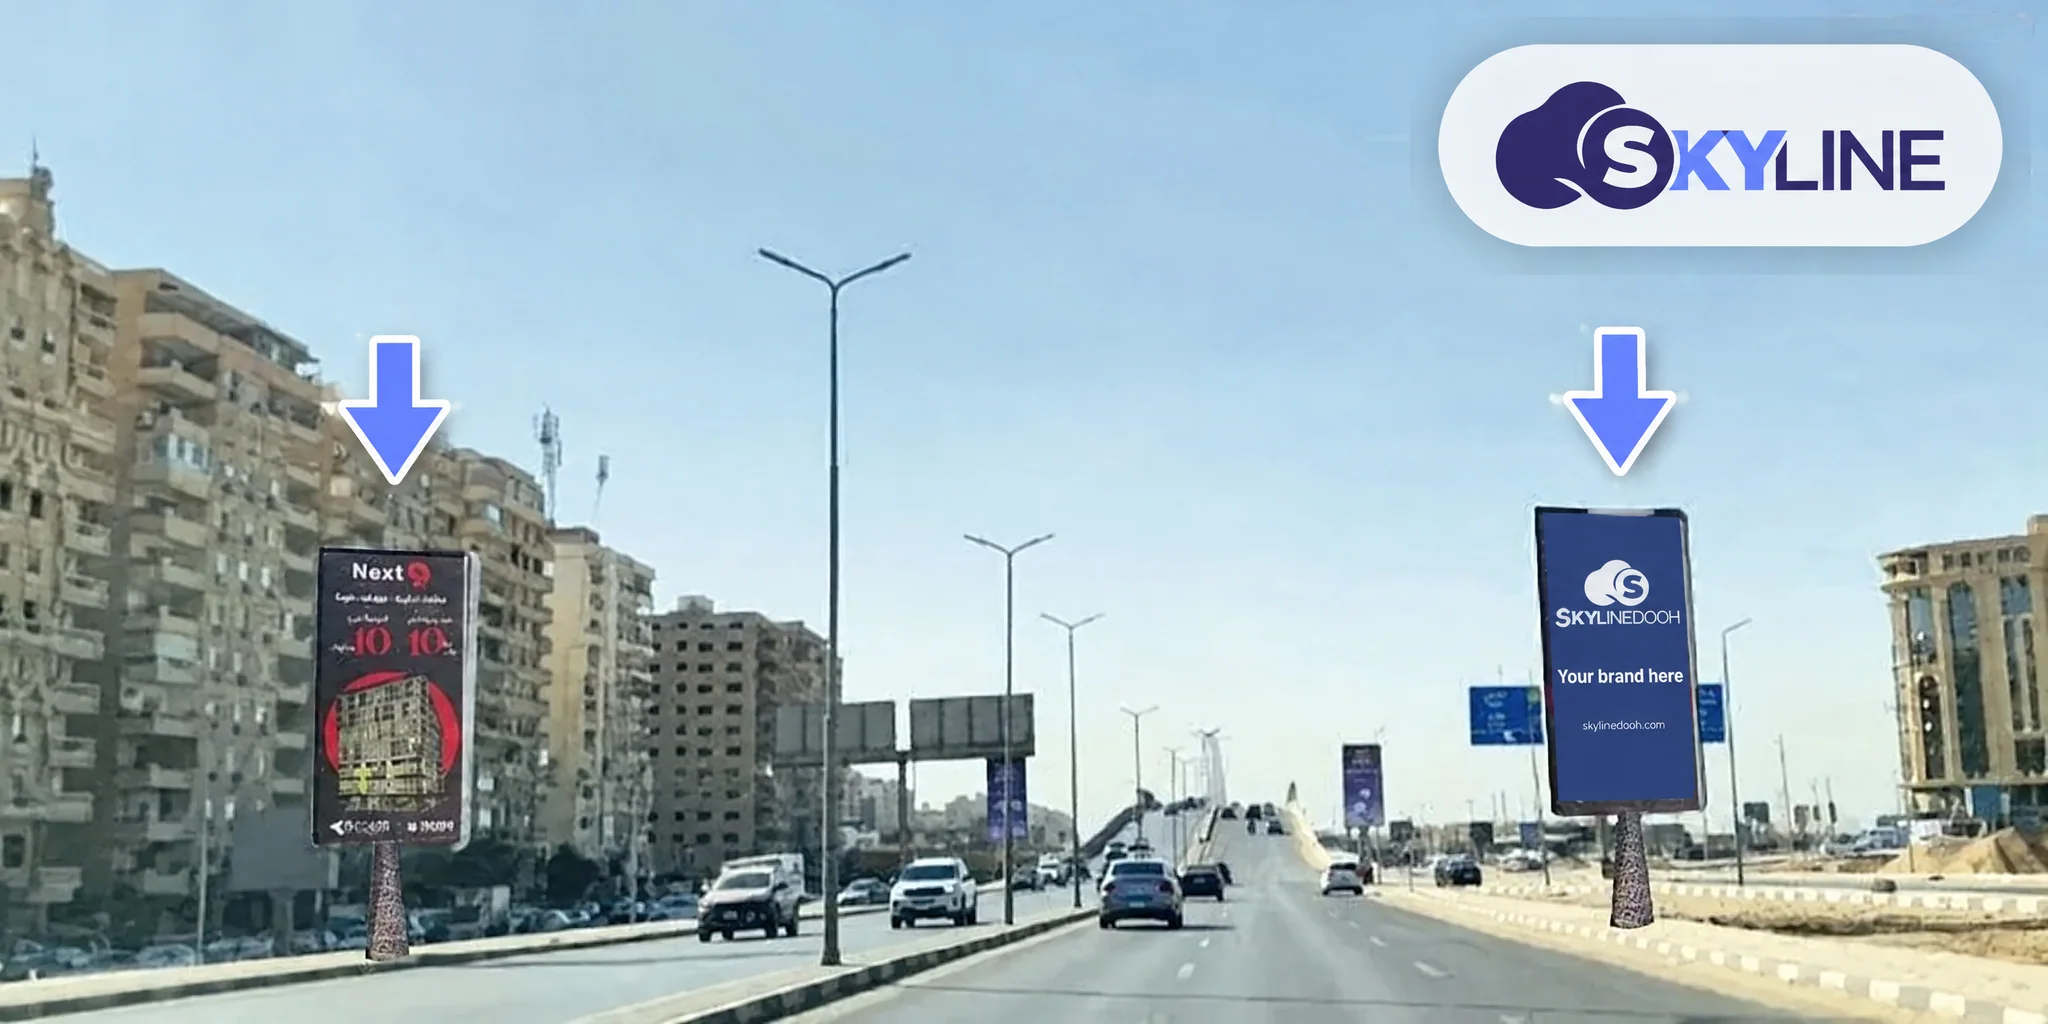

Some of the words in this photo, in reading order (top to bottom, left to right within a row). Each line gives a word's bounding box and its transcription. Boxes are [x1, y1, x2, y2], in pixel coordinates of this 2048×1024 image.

[352, 562, 404, 581] Next
[1622, 574, 1644, 600] S
[1555, 607, 1681, 628] SKYLINEDOOH
[354, 627, 392, 656] 10
[408, 627, 445, 656] 10
[1557, 668, 1594, 684] Your
[1597, 668, 1644, 684] brand
[1648, 668, 1684, 683] here
[1582, 720, 1666, 733] skylinedooh.com
